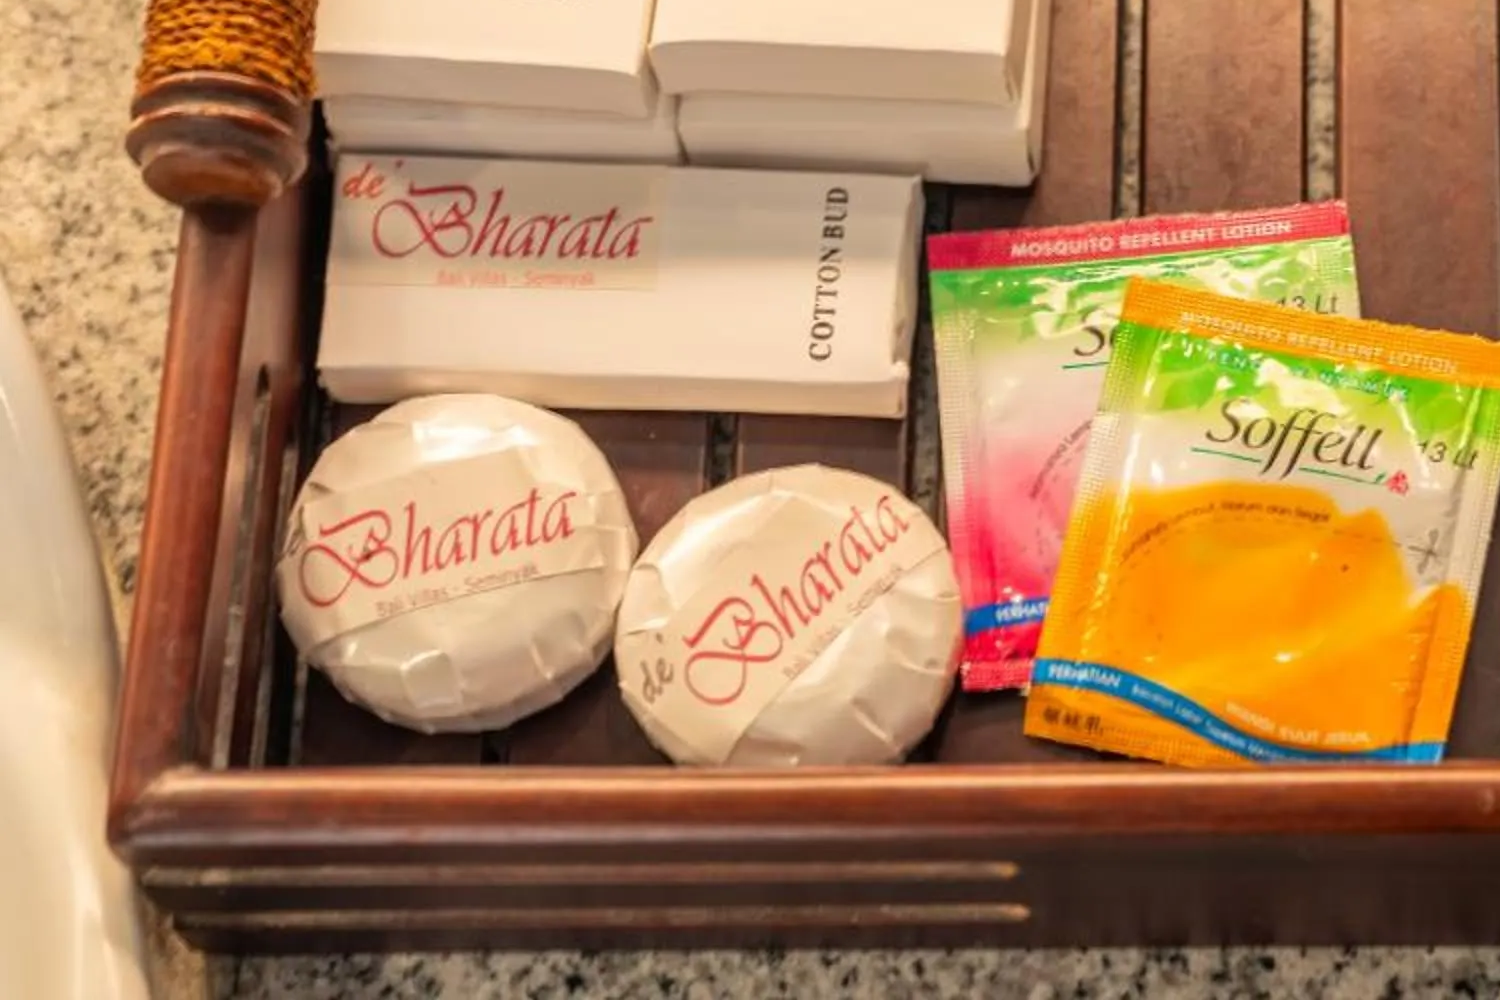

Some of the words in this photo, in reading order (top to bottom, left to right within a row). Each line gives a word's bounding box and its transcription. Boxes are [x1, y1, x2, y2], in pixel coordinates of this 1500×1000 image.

[372, 181, 654, 259] Bharata
[822, 186, 850, 240] BUD
[1011, 236, 1114, 258] MOSQUITO
[1119, 228, 1217, 248] REPELLENT
[1221, 220, 1293, 240] LOTION
[808, 247, 842, 361] COTTON
[1180, 311, 1283, 344] MOSQUITO
[1286, 332, 1384, 360] REPELLENT
[1387, 351, 1459, 375] LOTION
[1204, 396, 1384, 481] Soffell
[300, 487, 578, 608] Bharata
[681, 494, 910, 706] Bharata
